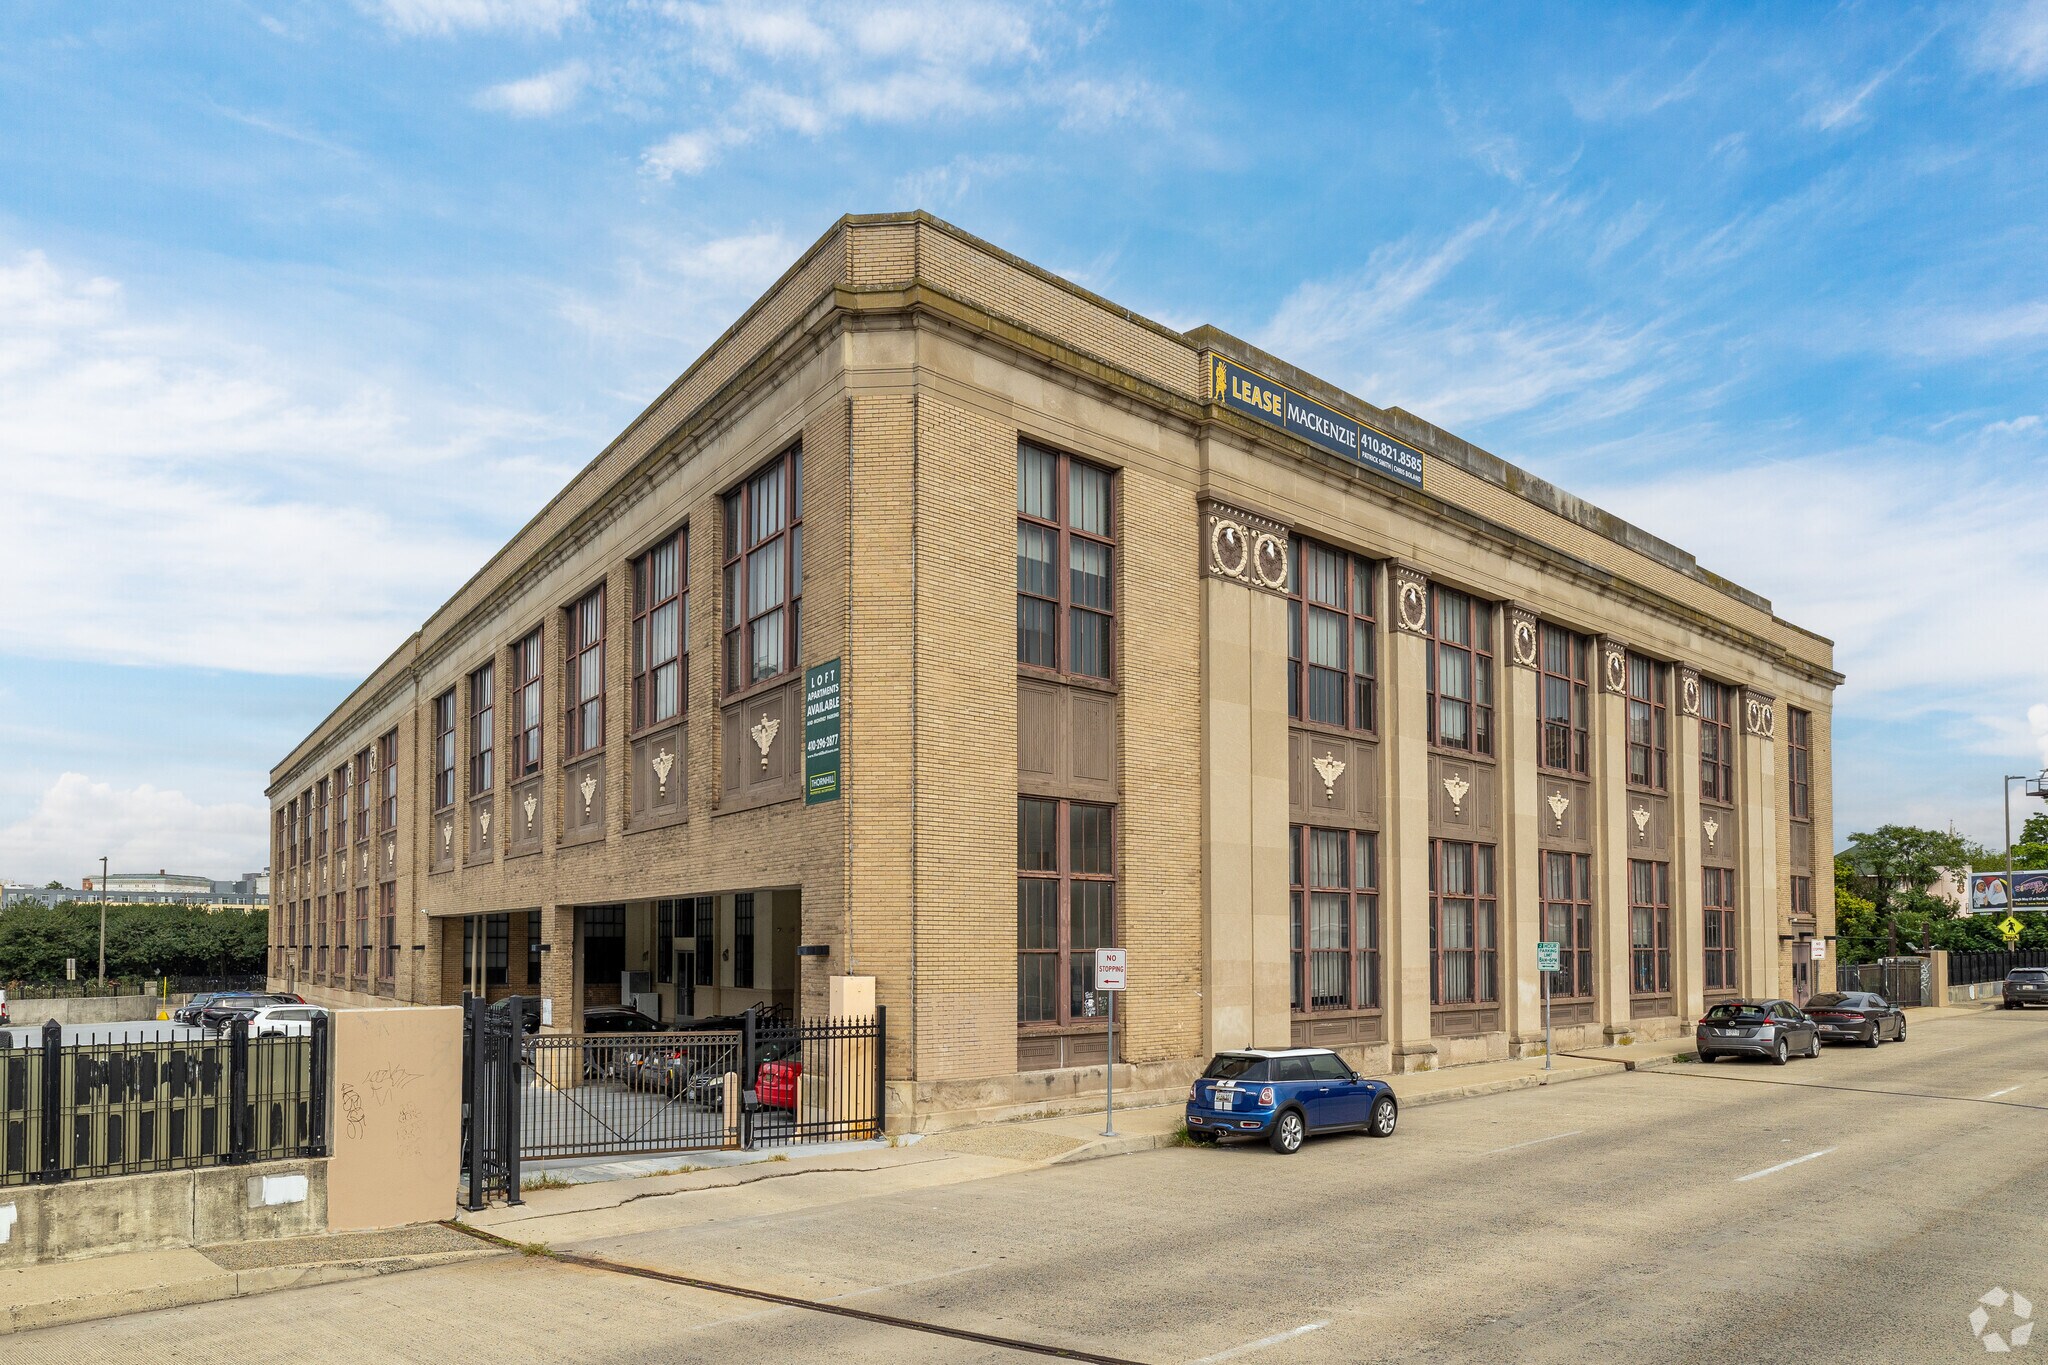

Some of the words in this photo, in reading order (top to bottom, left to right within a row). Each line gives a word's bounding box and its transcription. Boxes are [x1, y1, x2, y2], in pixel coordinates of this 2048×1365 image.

[1232, 376, 1282, 417] LEASE
[1287, 402, 1357, 449] MACKENZIE
[1360, 433, 1422, 472] 410.821.8585
[1361, 450, 1379, 464] PATRICK
[1393, 465, 1405, 476] CHRIS
[1405, 470, 1422, 483] BOLAND
[811, 669, 835, 688] LOFT
[807, 683, 839, 702] APARTMENTS
[806, 696, 840, 717] AVAILABLE
[811, 775, 835, 787] THORNHILL
[1099, 965, 1124, 973] STOPPING
